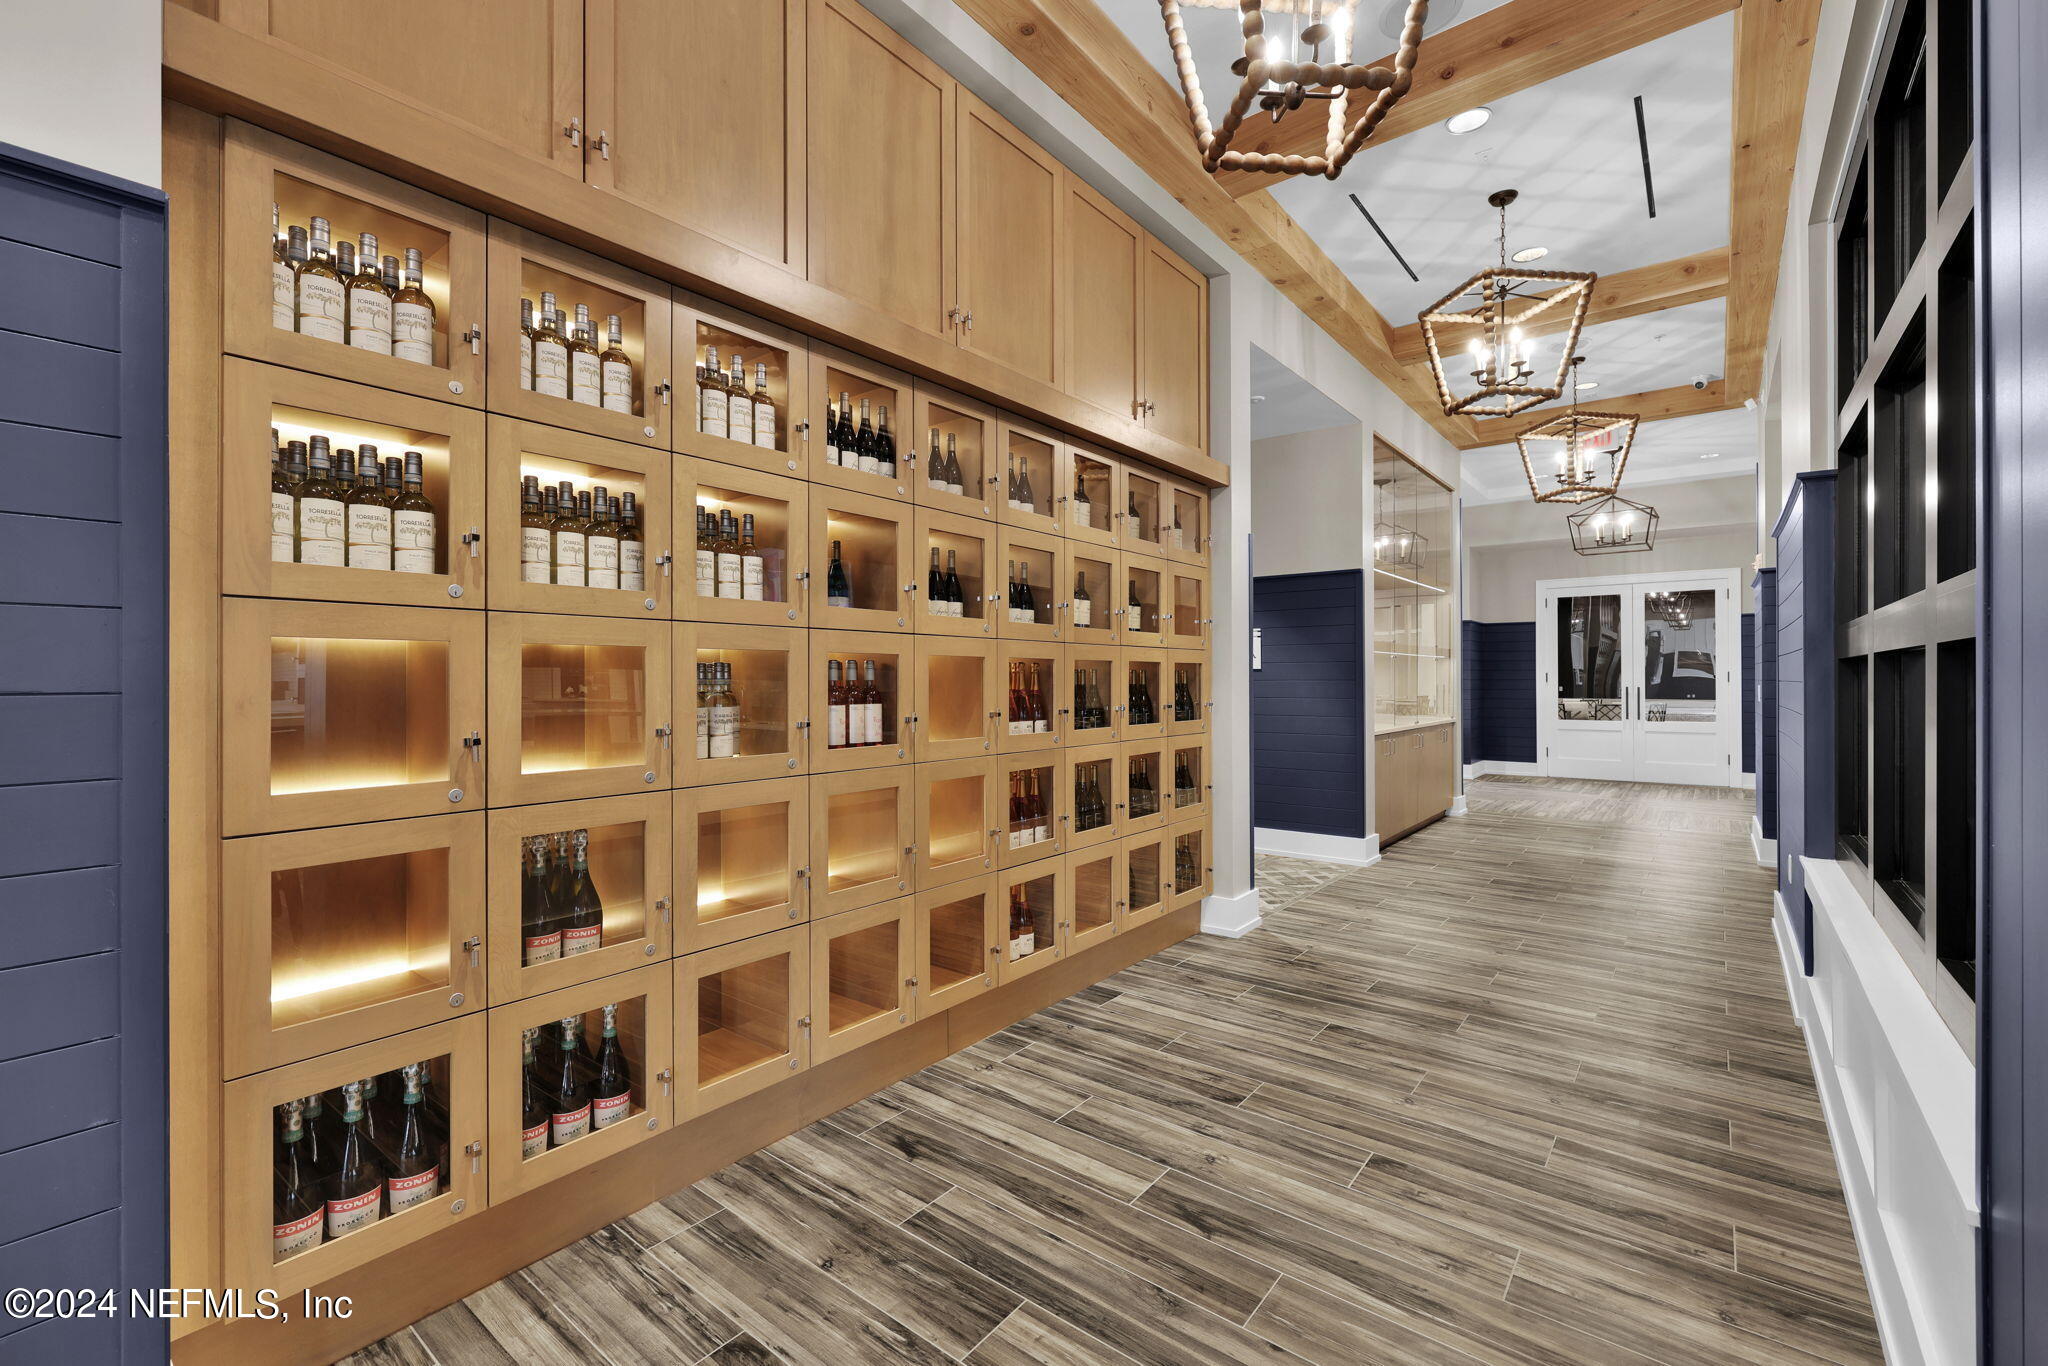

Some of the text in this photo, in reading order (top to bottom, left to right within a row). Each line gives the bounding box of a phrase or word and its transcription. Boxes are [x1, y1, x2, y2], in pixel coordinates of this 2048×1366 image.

[307, 284, 342, 298] TORRESELLA
[357, 298, 389, 311] TORRESELLA
[396, 311, 428, 321] TORRESELLA
[308, 507, 342, 517] TORRESELLA
[356, 513, 388, 522] TORRESELLA
[400, 519, 432, 527] TORRESELLA
[566, 928, 598, 938] ZONIN
[599, 1095, 629, 1108] ZONIN
[559, 1109, 589, 1123] ZONIN
[394, 1171, 435, 1189] ZONIN
[334, 1192, 377, 1212] ZONIN
[398, 1187, 432, 1206] PROSECCO
[275, 1214, 320, 1236] ZONIN
[337, 1208, 375, 1229] PROSECCO
[278, 1231, 318, 1254] PROSECCO
